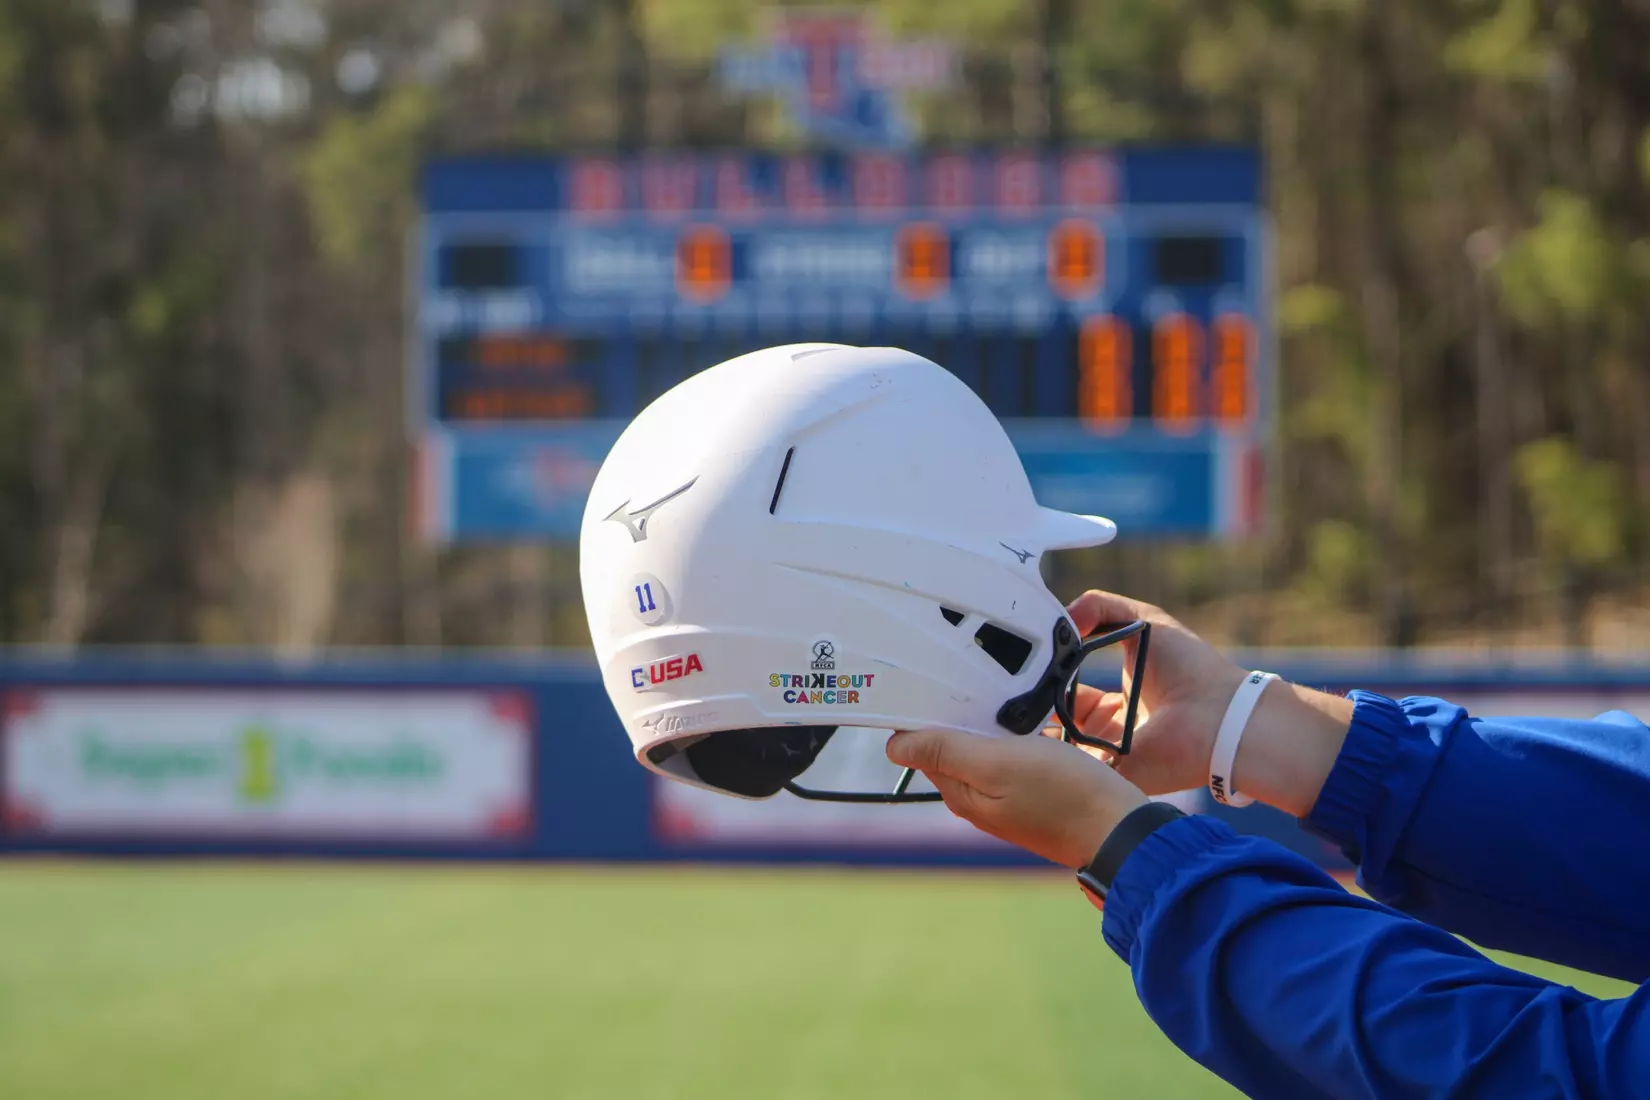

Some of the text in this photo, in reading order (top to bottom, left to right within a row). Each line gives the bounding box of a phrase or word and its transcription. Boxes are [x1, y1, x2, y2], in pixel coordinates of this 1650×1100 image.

[635, 583, 656, 613] 11
[769, 673, 875, 688] STRIKEOUT
[783, 690, 859, 704] CANCER
